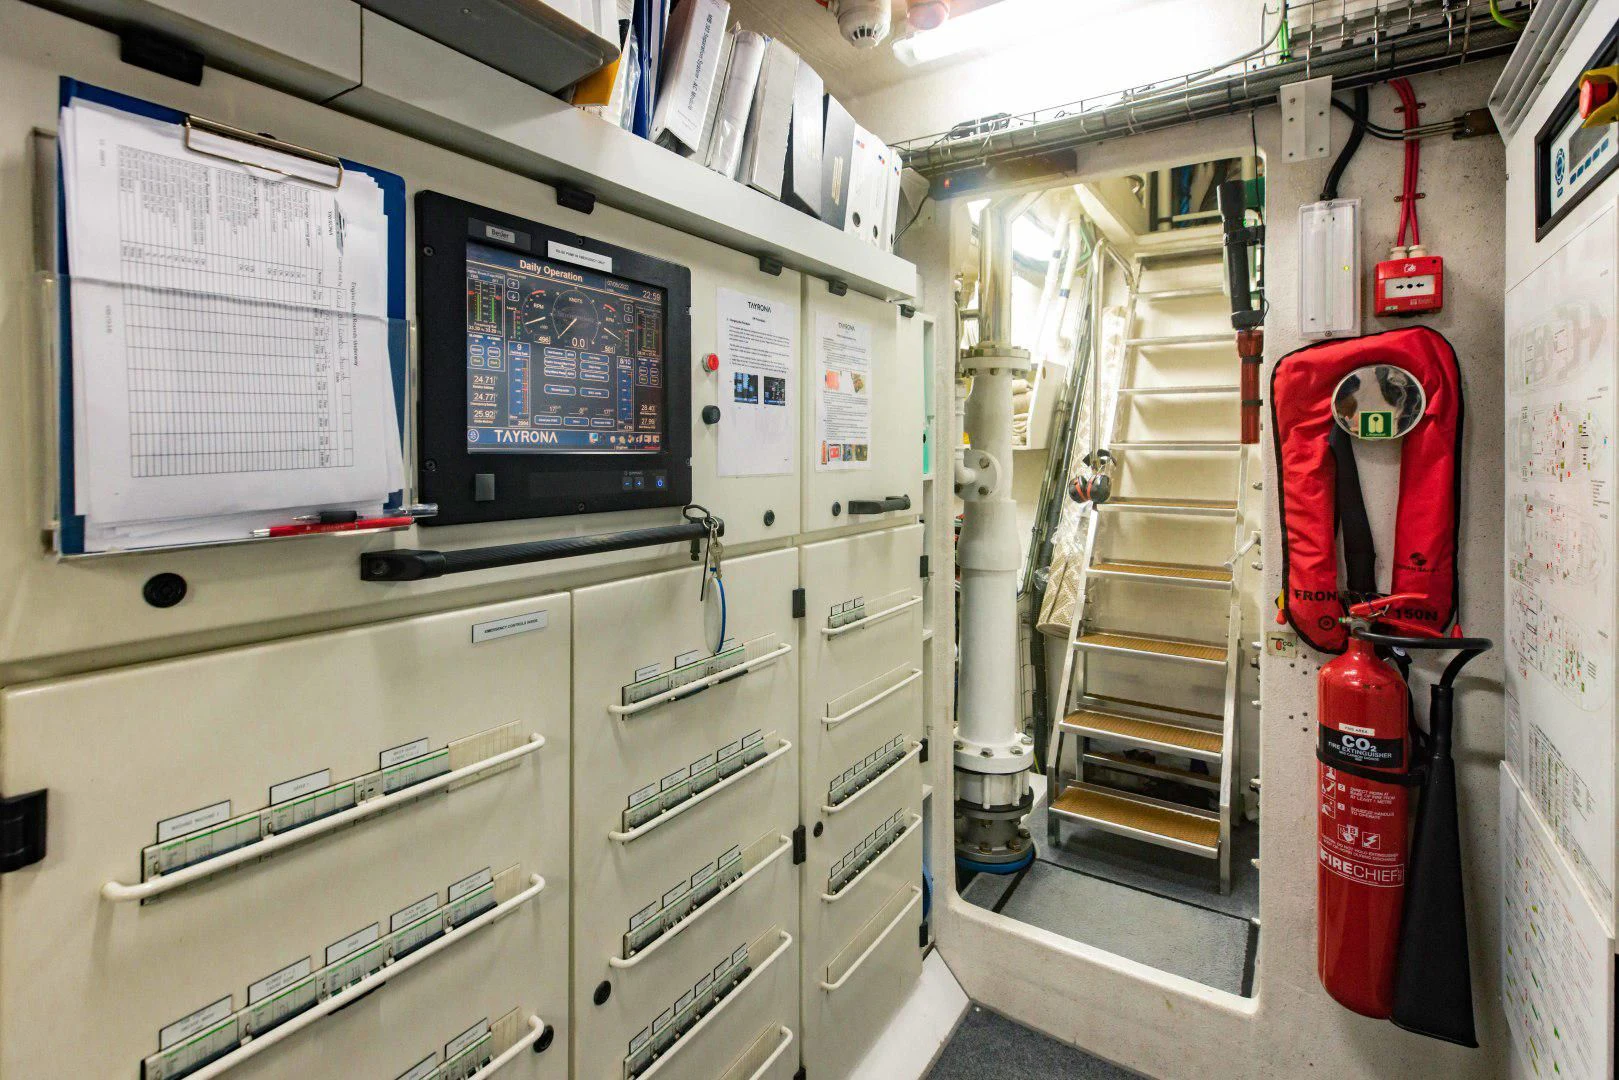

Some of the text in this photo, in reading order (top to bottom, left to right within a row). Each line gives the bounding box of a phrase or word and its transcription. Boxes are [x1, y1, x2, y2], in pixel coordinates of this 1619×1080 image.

[698, 33, 710, 58] Separation
[694, 58, 704, 78] System
[692, 82, 699, 90] AC
[520, 260, 542, 274] Daily
[543, 265, 584, 282] Operation
[642, 290, 661, 301] 22:59
[748, 302, 772, 314] TAYRONA
[572, 337, 586, 348] 0.0
[474, 376, 494, 384] 24.71
[474, 392, 494, 400] 24.77
[474, 410, 494, 418] 25.92
[494, 430, 558, 443] TAYRONA
[1294, 588, 1338, 601] FRON
[1395, 608, 1438, 622] 150N
[1328, 741, 1341, 750] FIRE
[1342, 746, 1392, 758] EXTINGUISHER
[1320, 848, 1398, 882] FIRECHIEF
